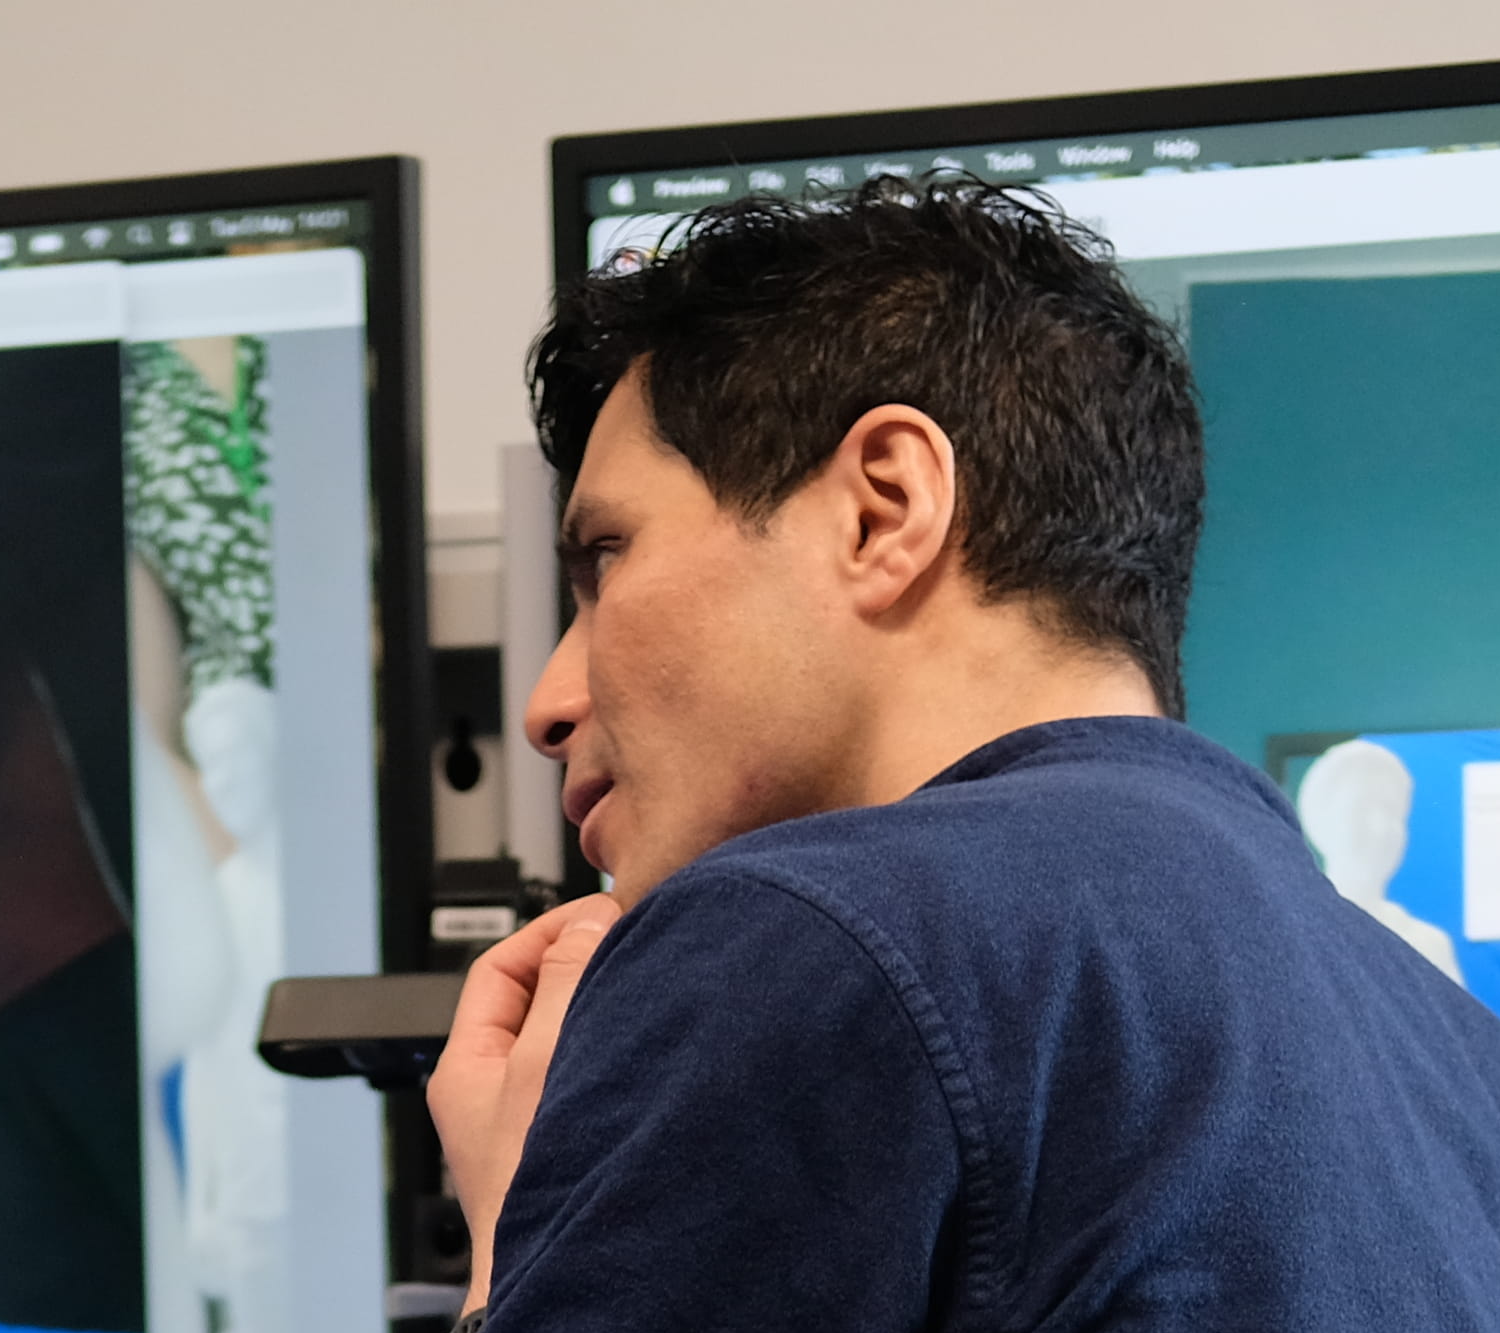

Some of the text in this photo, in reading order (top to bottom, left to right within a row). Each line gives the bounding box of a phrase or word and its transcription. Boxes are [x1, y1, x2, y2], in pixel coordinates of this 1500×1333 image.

[984, 151, 1036, 172] Tools
[1057, 145, 1133, 167] Window
[1152, 138, 1200, 161] Help
